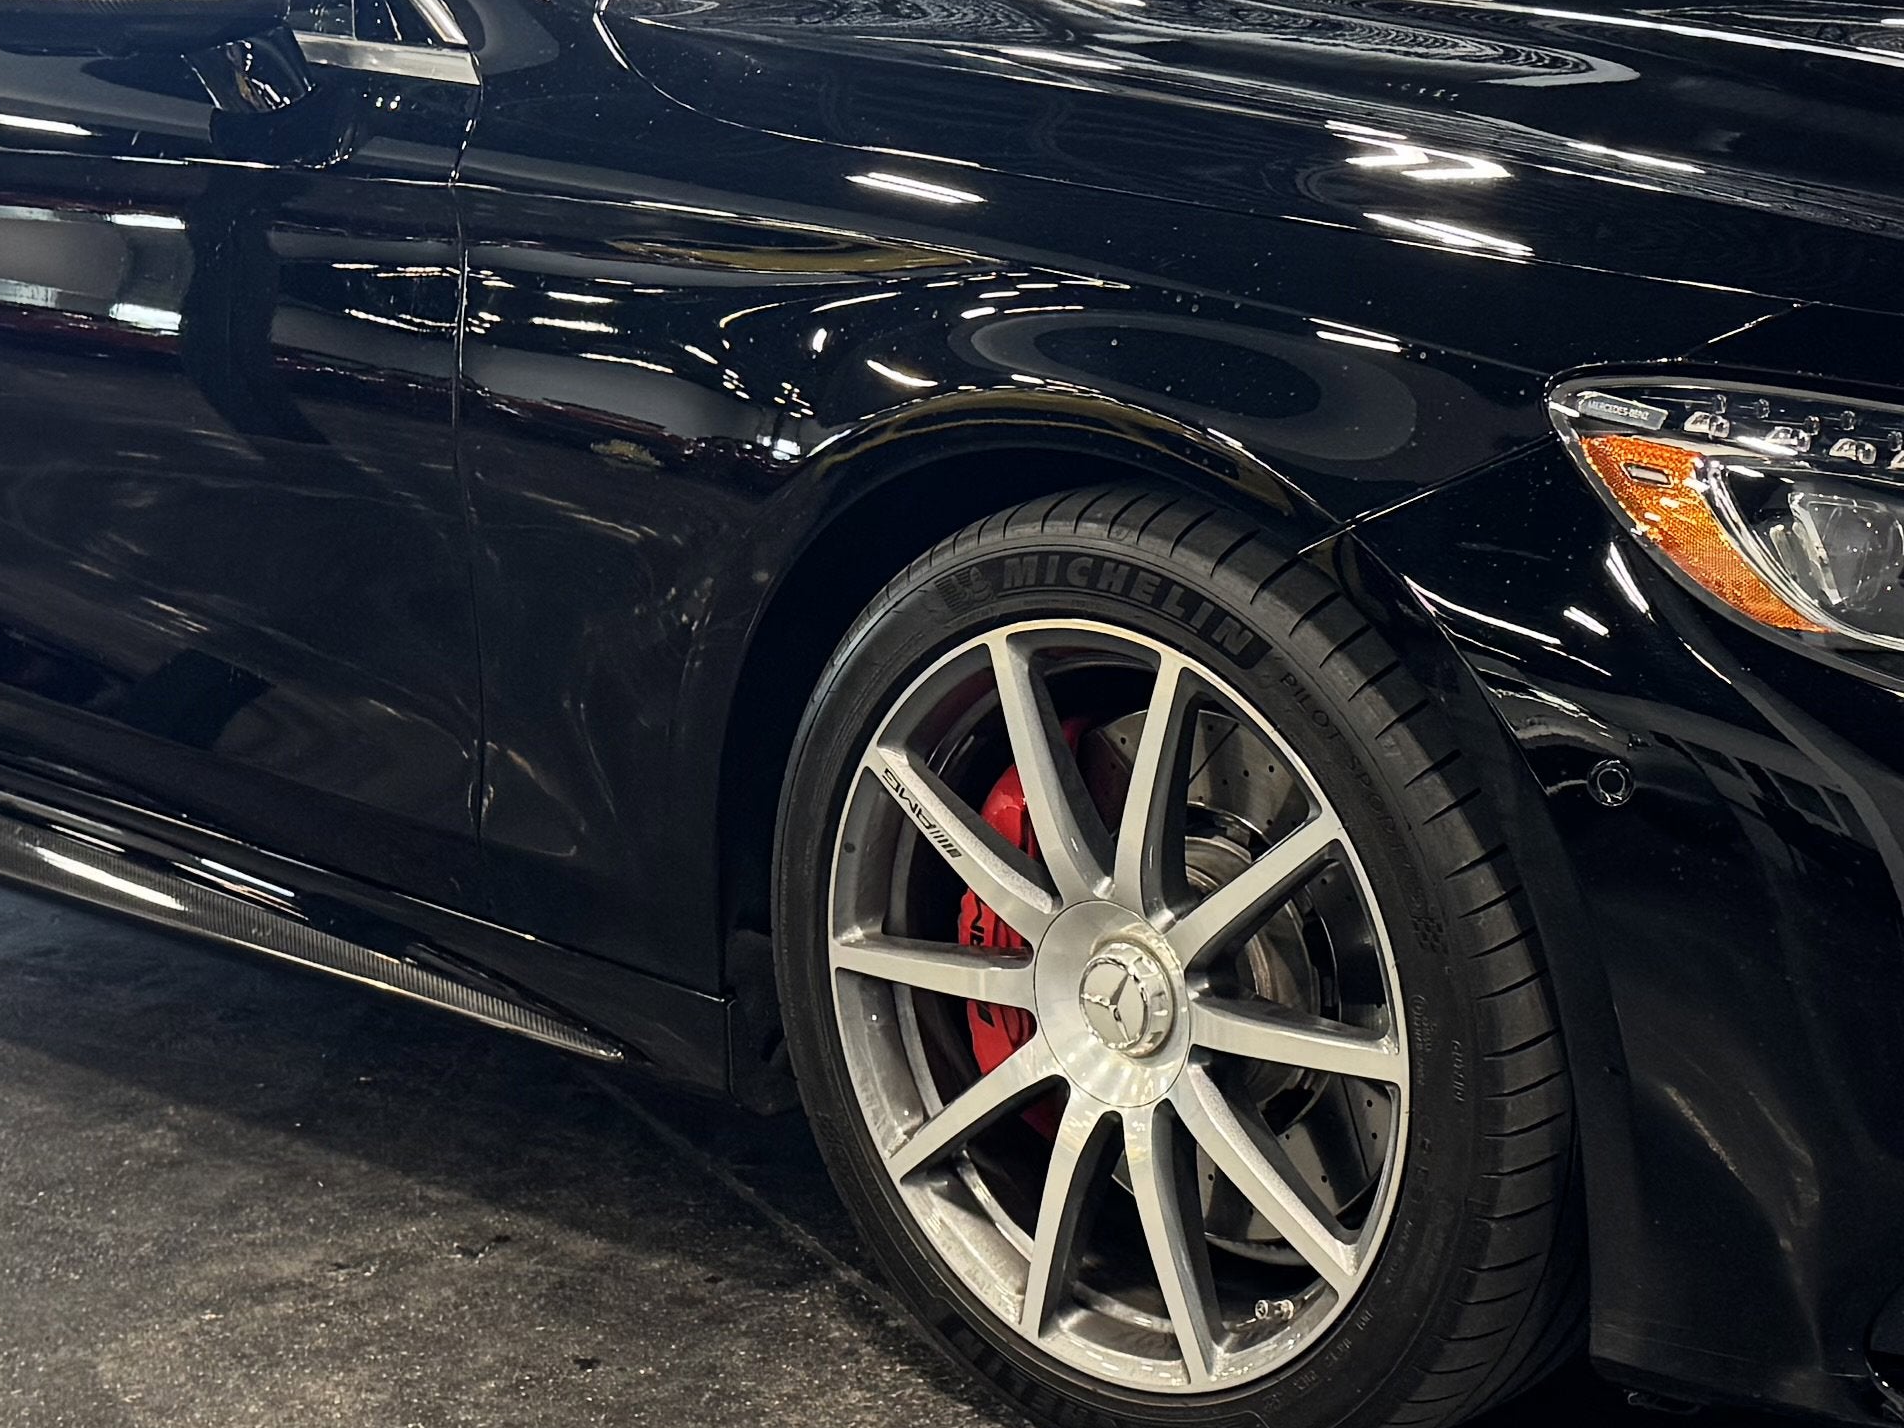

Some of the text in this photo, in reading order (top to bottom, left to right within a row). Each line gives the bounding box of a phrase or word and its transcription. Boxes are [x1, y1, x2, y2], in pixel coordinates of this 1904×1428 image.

[1002, 555, 1254, 656] MICHELIN
[1280, 673, 1341, 740] PILOT
[882, 768, 937, 830] AMG
